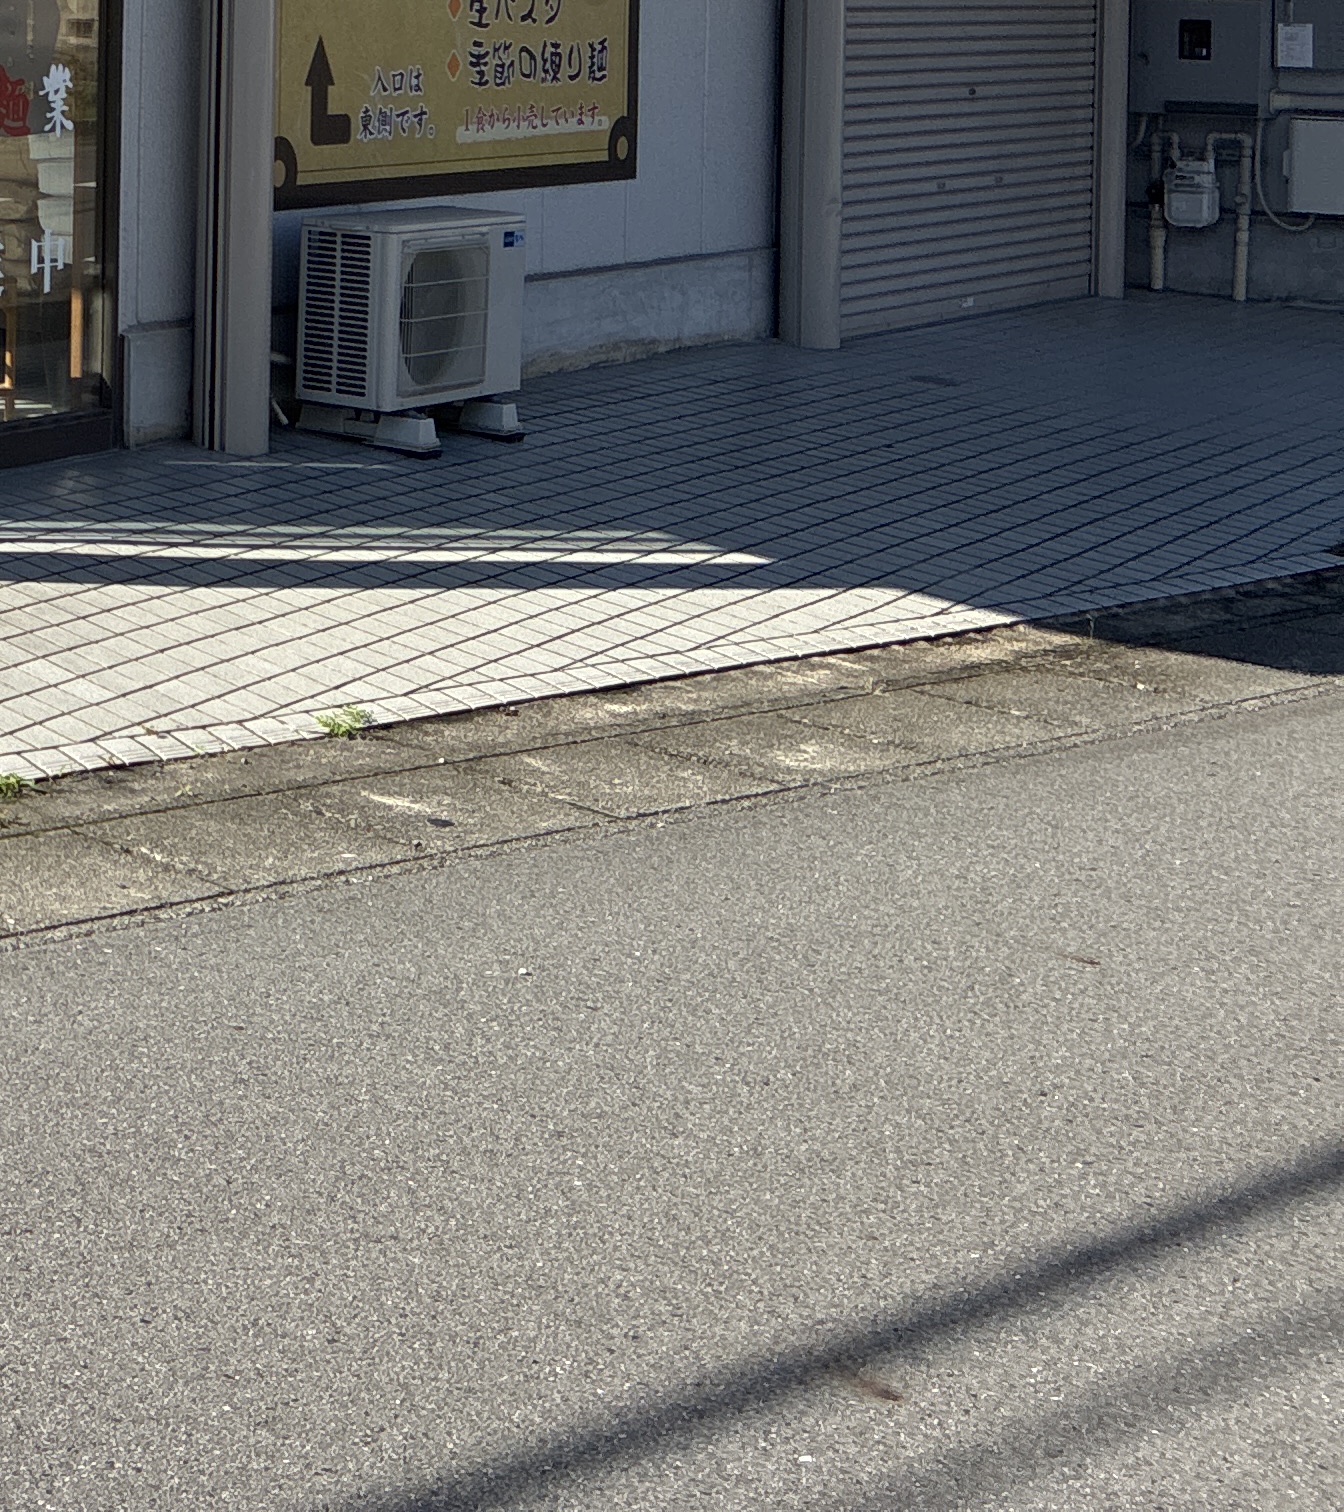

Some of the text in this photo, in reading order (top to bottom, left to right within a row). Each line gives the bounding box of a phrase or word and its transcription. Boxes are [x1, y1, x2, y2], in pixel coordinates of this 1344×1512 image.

[372, 67, 423, 94] 入口は
[468, 37, 609, 88] 季節の練り麺
[357, 104, 436, 141] 東側です。
